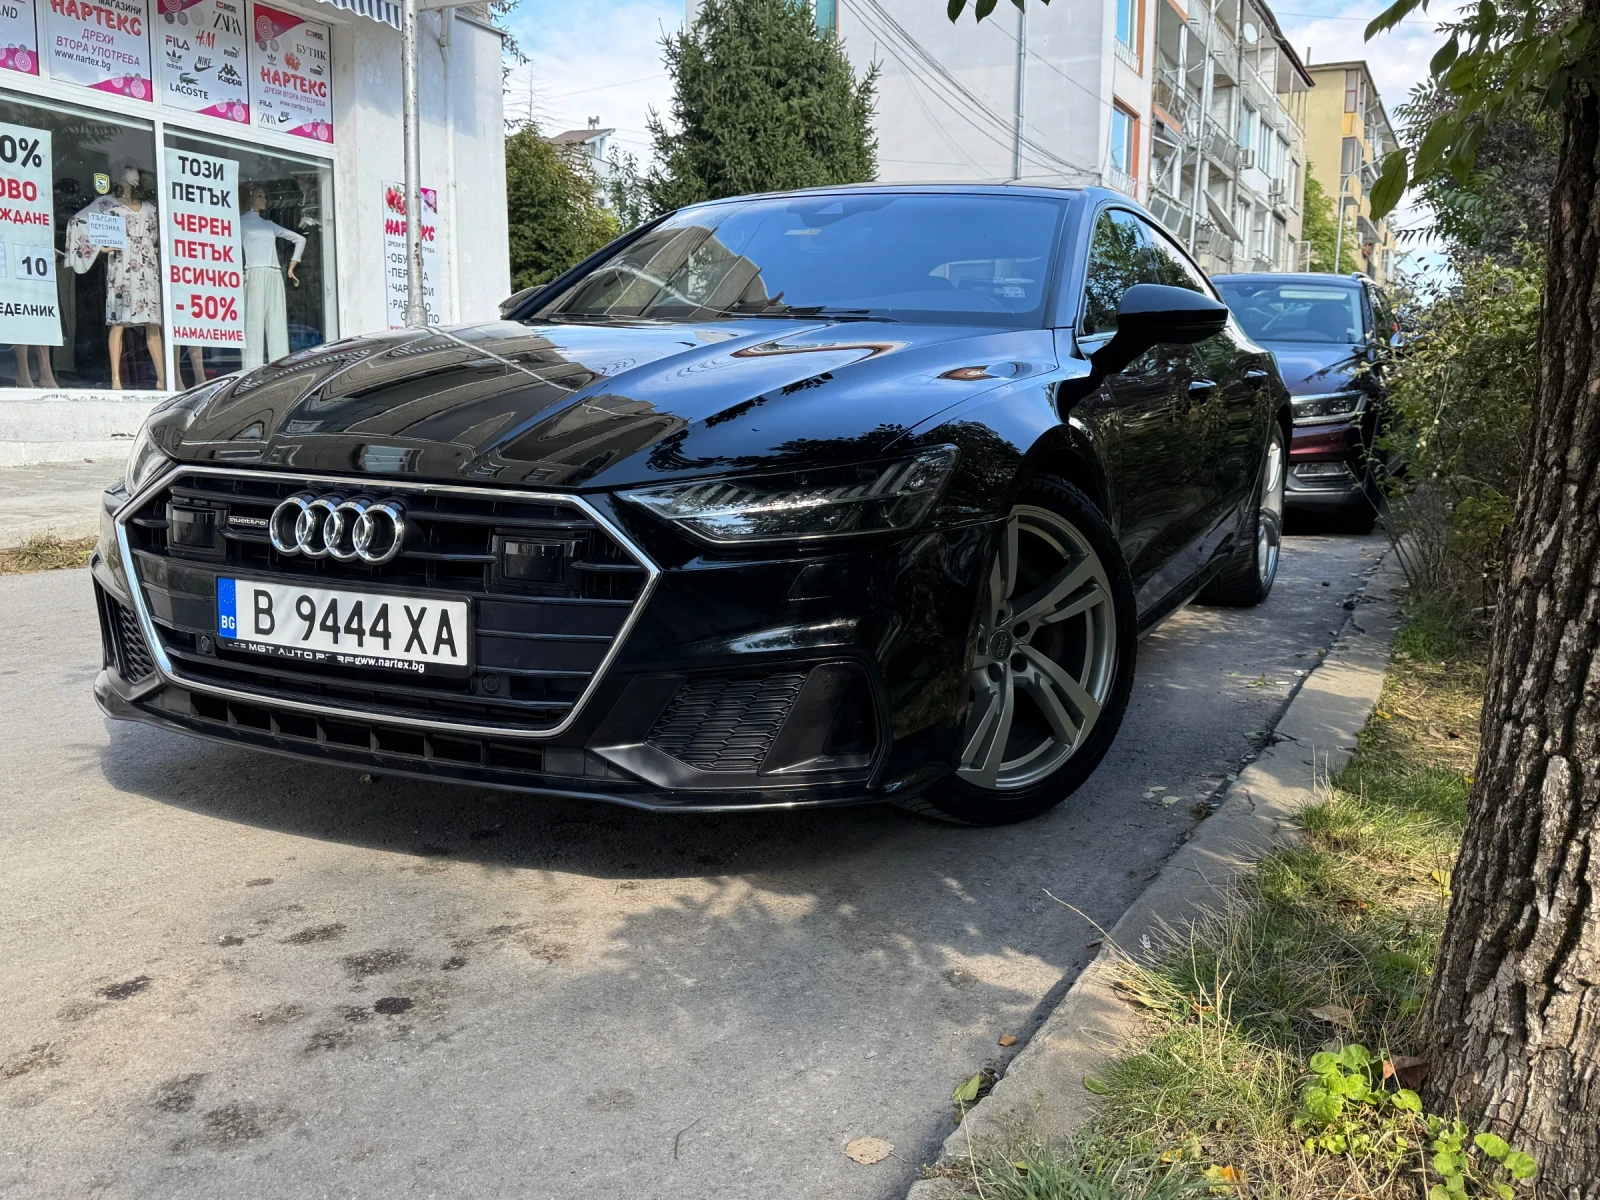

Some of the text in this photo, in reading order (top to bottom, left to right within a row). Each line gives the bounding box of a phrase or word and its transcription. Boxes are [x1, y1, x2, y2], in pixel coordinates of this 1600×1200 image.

[0, 4, 18, 19] ND
[98, 0, 141, 16] МАГАЗИНИ
[50, 0, 141, 36] НАРТЕКС
[212, 11, 242, 36] ZARA
[81, 28, 114, 46] ДРЕХИ
[165, 34, 190, 51] FILA
[54, 48, 111, 71] www.nartex.bg
[56, 35, 140, 66] ВТОРА УПОТРЕБА
[296, 43, 327, 61] БУТИК
[166, 62, 183, 71] adidas
[197, 55, 212, 67] NIKE
[217, 73, 242, 87] Kappa
[260, 65, 327, 98] НАРТЕКС
[169, 82, 209, 100] LACOSTE
[264, 86, 326, 107] ДРЕХИ ВТОРА УПОТРЕБА
[279, 100, 313, 114] www.nartex.bg
[178, 155, 224, 181] ТОЗИ
[171, 181, 232, 208] ПЕТЪК
[173, 212, 232, 237] ЧЕРЕН
[385, 218, 435, 242] НАРКС
[174, 239, 235, 263] ПЕТЪК
[21, 256, 48, 276] 10
[170, 264, 240, 288] ВСИЧКО
[173, 325, 244, 342] НАМАЛЕНИЕ
[229, 517, 266, 526] quattro
[221, 615, 236, 630] BG
[253, 588, 458, 658] B 9444 XA
[248, 643, 274, 654] MGT
[278, 647, 313, 659] AUTO
